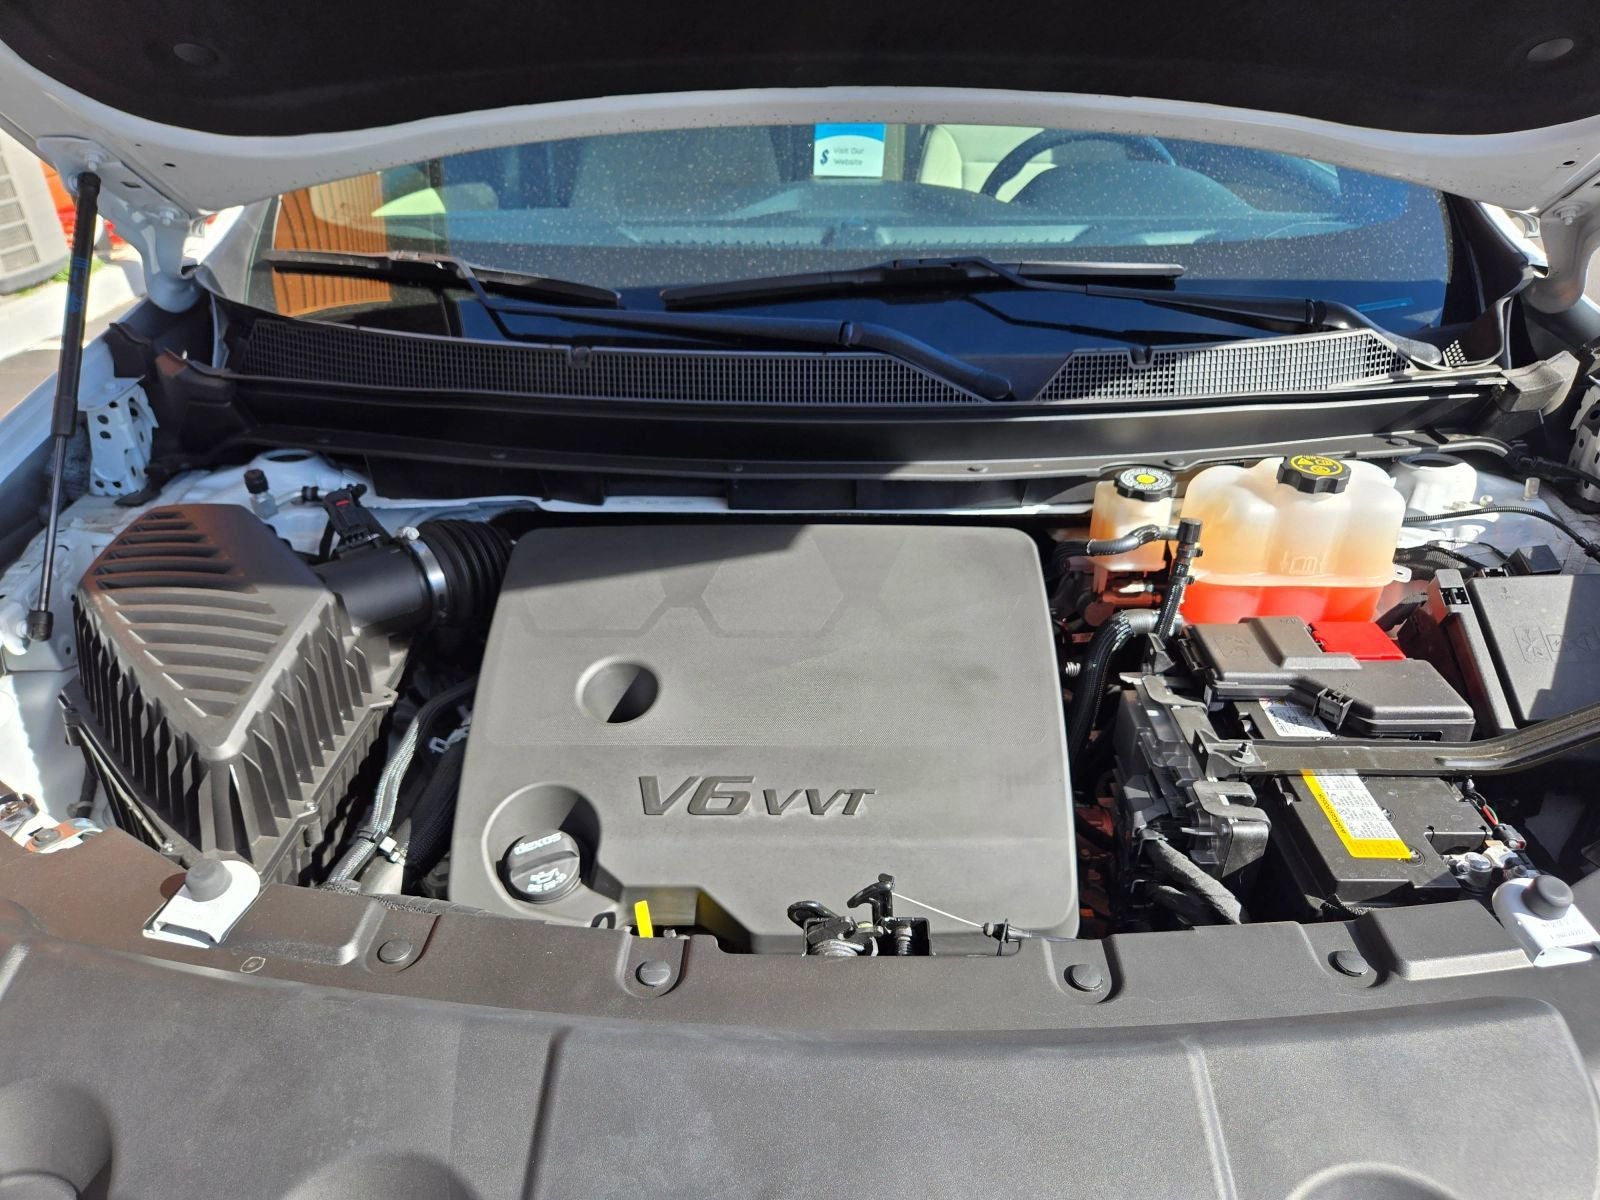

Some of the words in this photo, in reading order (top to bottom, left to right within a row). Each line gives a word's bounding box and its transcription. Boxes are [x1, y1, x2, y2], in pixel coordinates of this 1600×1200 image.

[850, 147, 864, 155] Our
[833, 158, 863, 166] Website
[638, 776, 755, 816] V6
[762, 789, 877, 816] VVT
